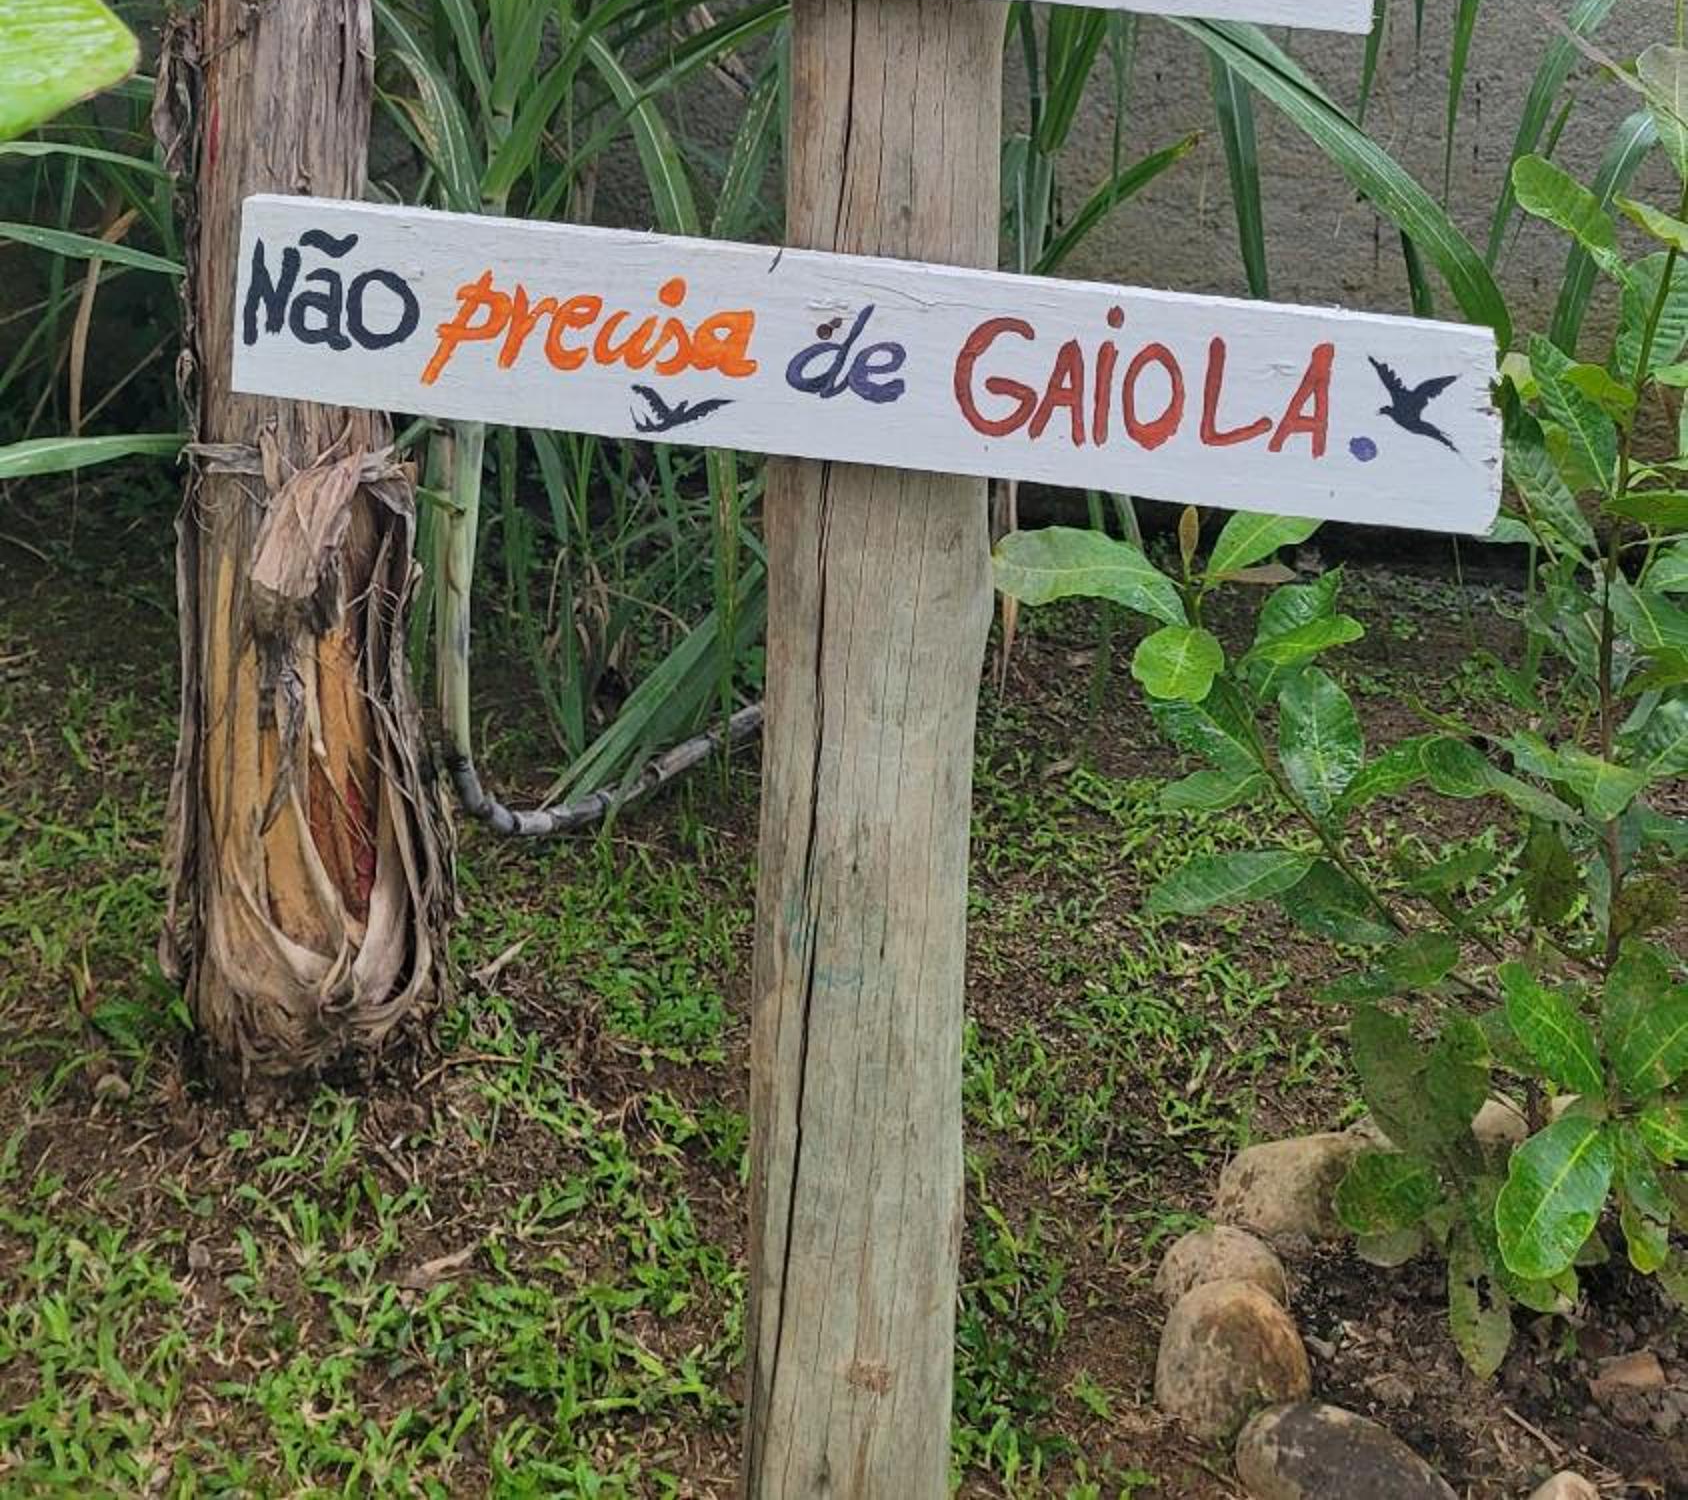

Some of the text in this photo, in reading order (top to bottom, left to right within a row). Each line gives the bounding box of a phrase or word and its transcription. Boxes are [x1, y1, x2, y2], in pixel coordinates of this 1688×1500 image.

[243, 228, 420, 350] Não
[420, 268, 758, 386] precisa
[785, 303, 906, 403] de
